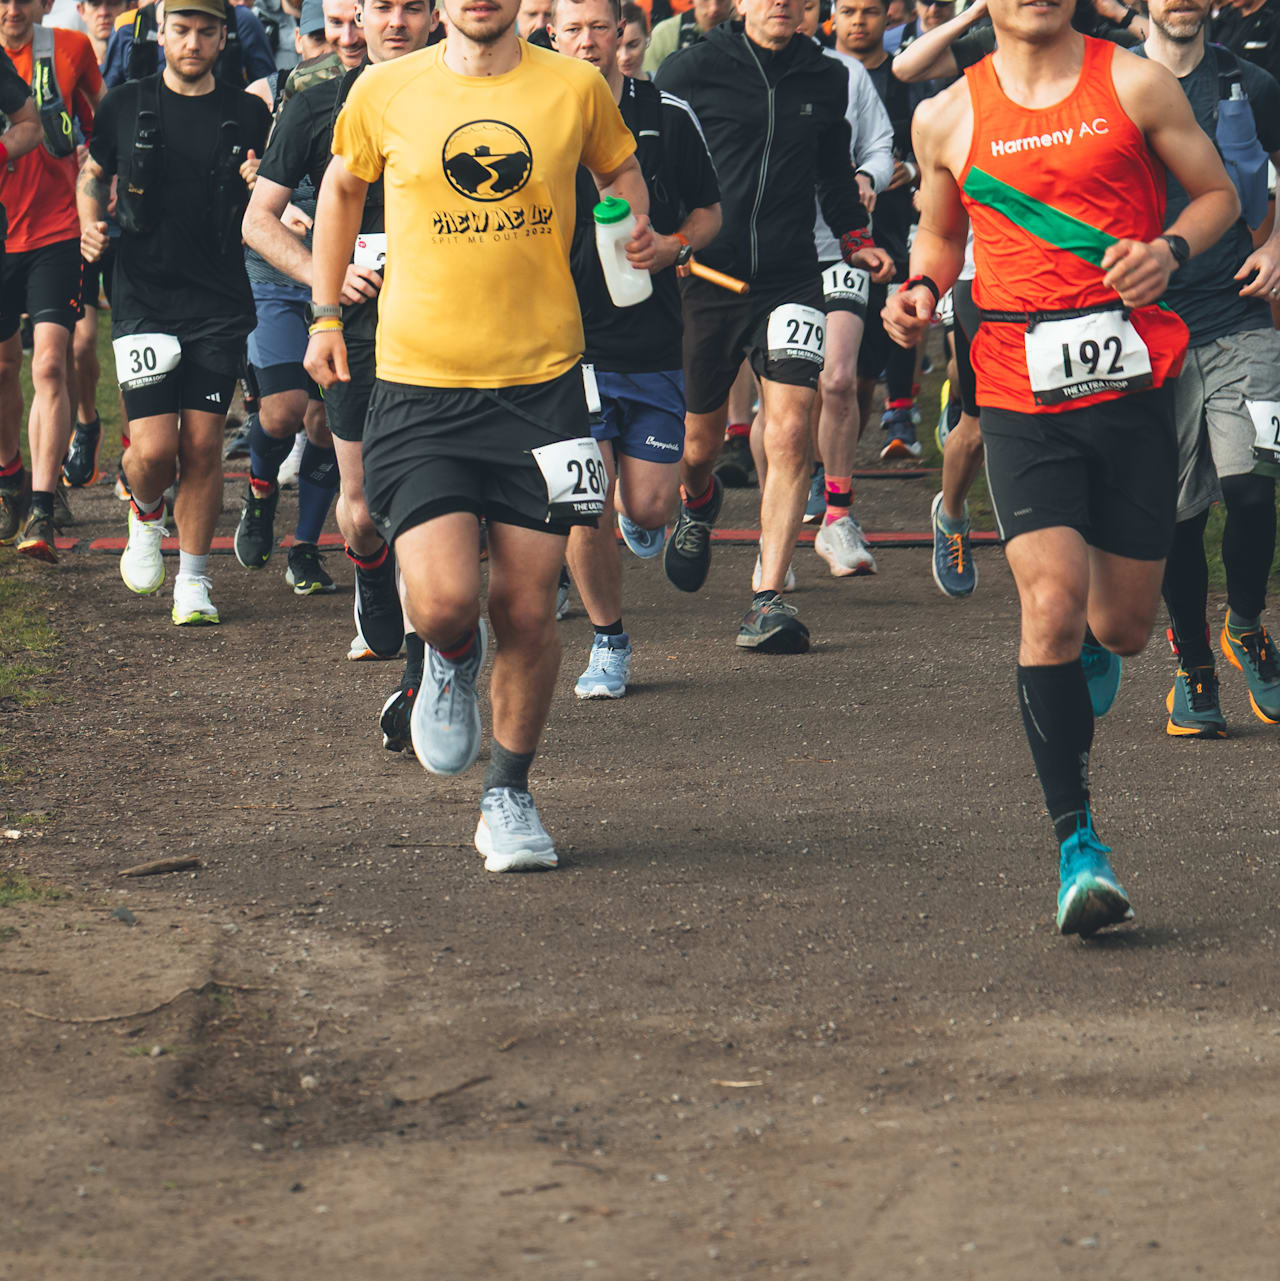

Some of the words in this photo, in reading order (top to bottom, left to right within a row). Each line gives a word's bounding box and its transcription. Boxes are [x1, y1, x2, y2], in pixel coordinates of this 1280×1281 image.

[991, 128, 1074, 157] Harmeny
[1079, 118, 1110, 138] AC
[494, 207, 525, 231] ME
[431, 236, 459, 245] SPIT
[467, 235, 484, 244] ME
[493, 233, 518, 242] OUT
[525, 227, 552, 237] 2022
[832, 270, 866, 293] 167
[786, 319, 824, 351] 279
[130, 347, 157, 373] 30
[1062, 336, 1124, 378] 192
[1063, 386, 1078, 397] THE
[1079, 381, 1105, 392] ULTRA
[567, 458, 606, 495] 280
[572, 503, 588, 511] THE
